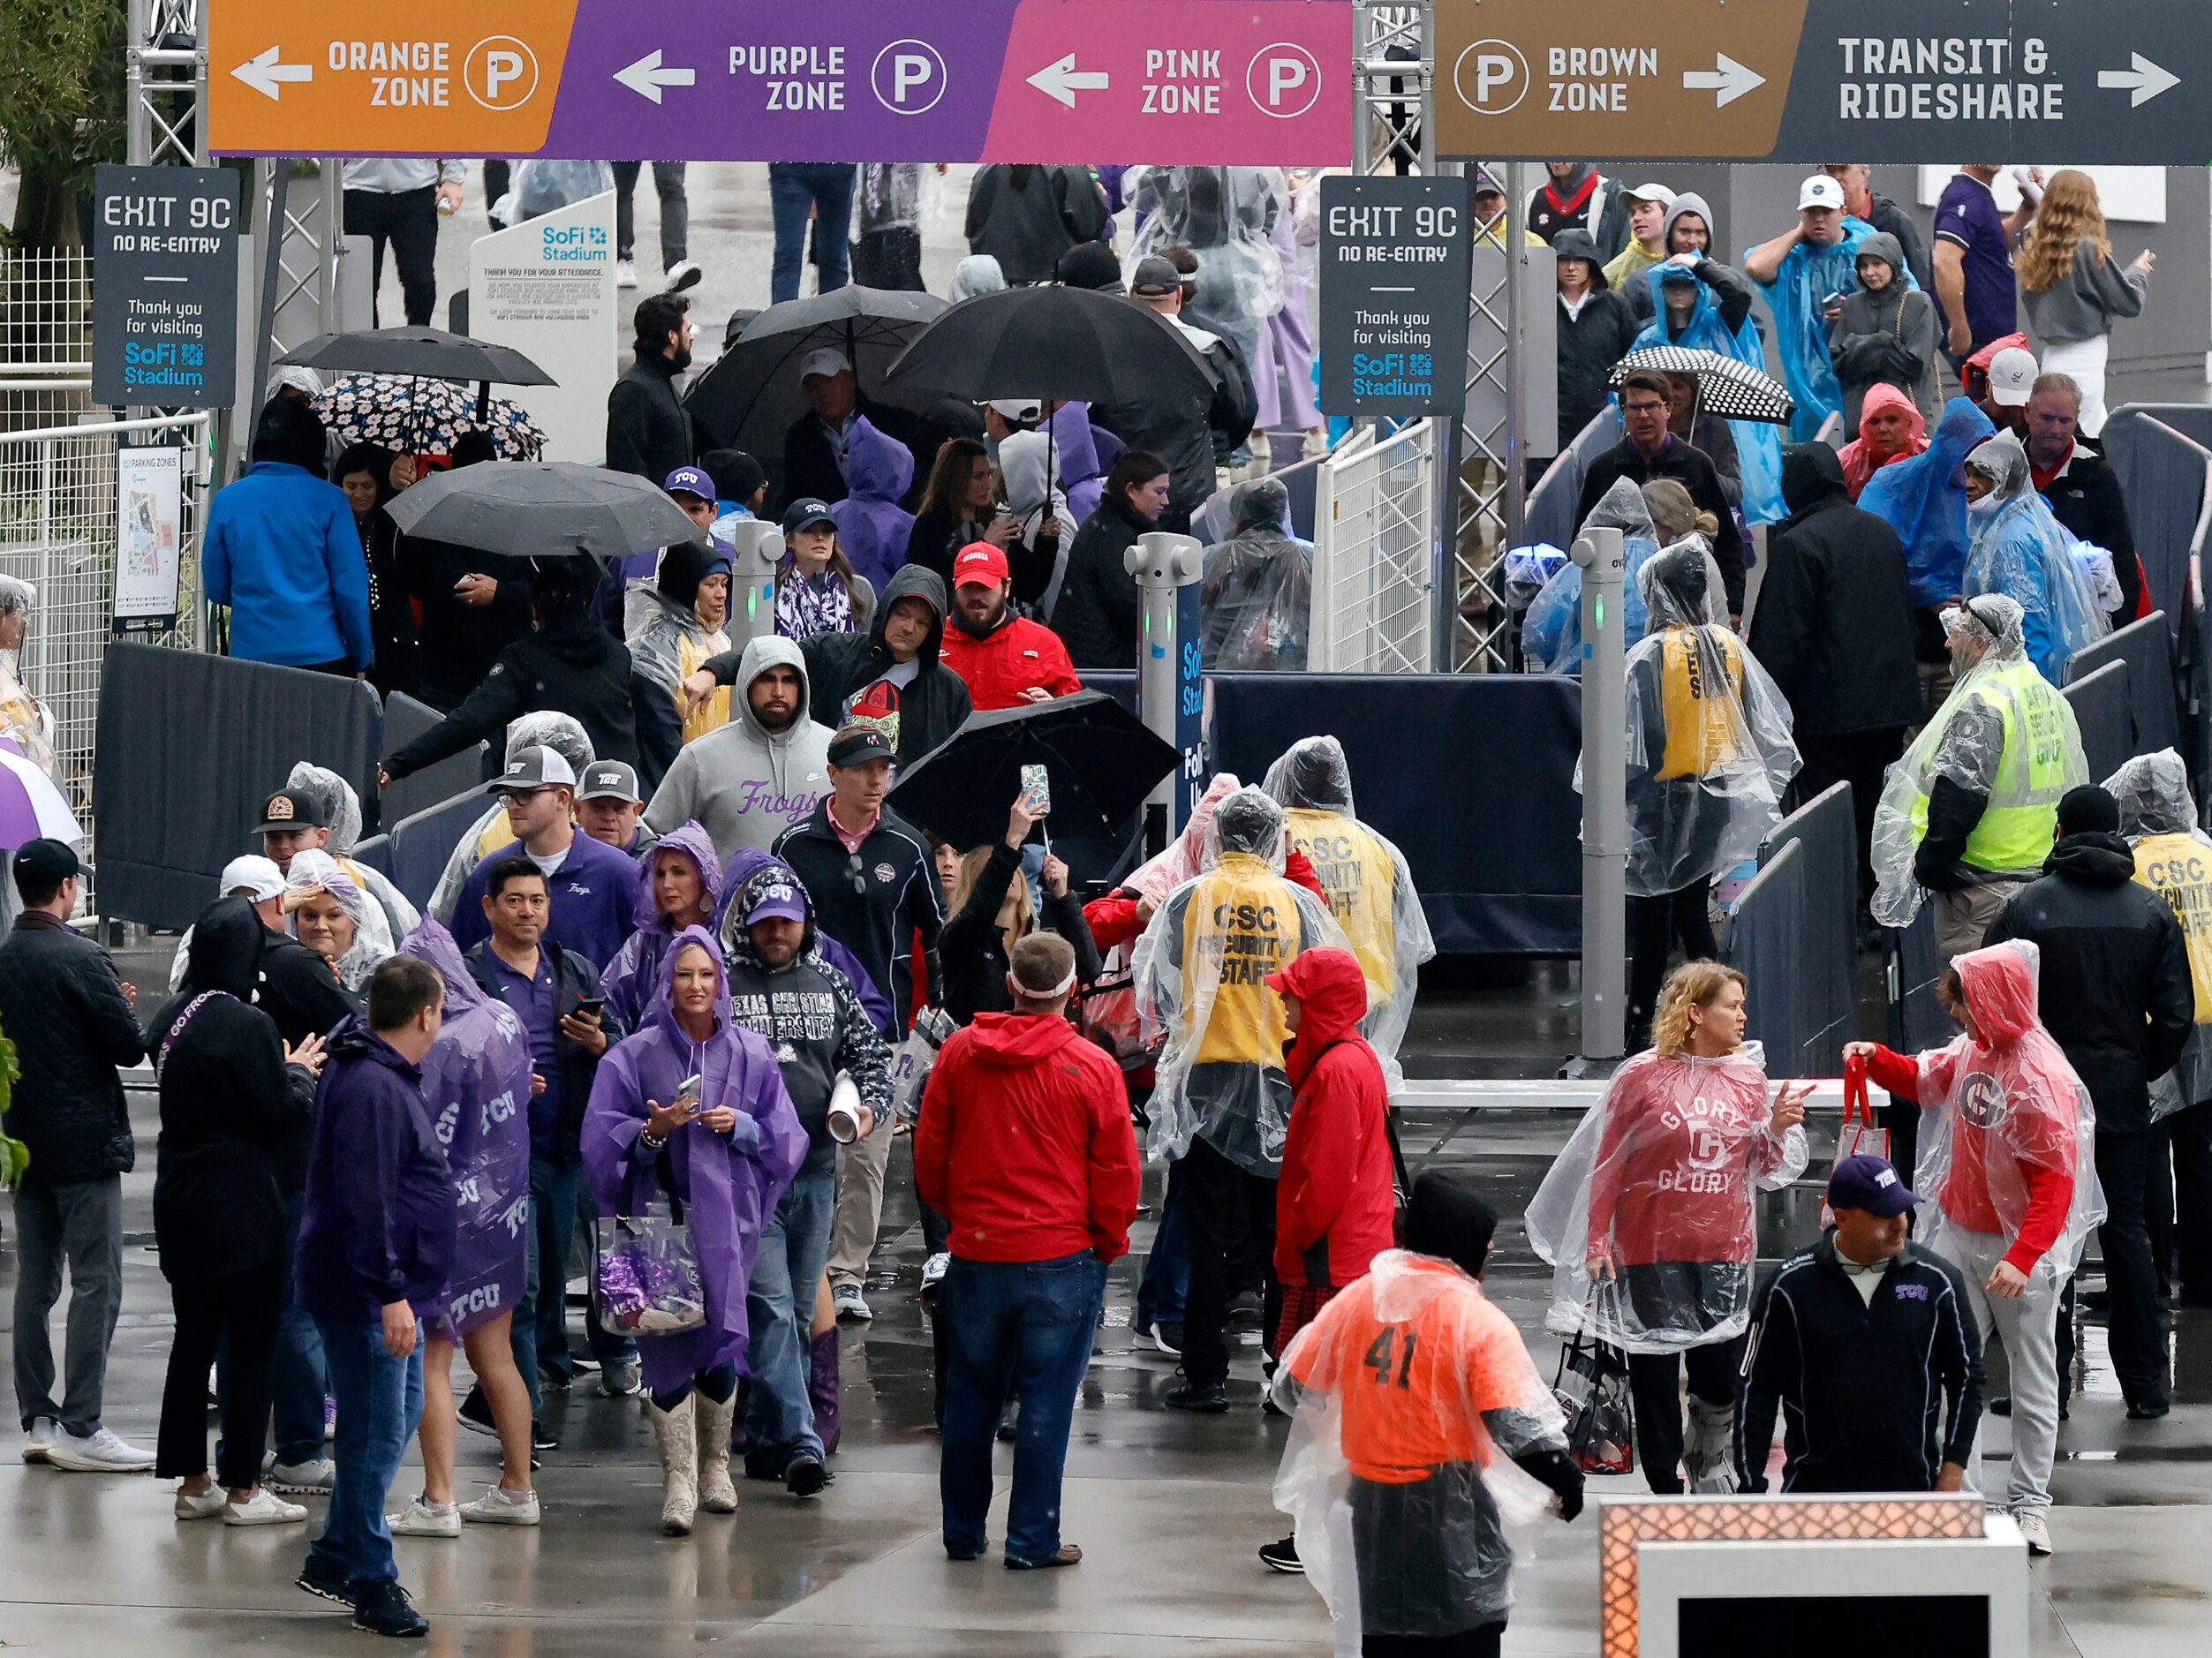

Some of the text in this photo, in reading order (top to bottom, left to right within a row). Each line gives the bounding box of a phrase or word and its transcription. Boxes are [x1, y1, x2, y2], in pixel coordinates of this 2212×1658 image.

[328, 41, 449, 71] ORANGE
[729, 46, 844, 75] PURPLE
[1146, 49, 1220, 79] PINK
[1548, 47, 1657, 76] BROWN
[1838, 38, 2049, 74] TRANSIT &
[487, 51, 524, 98] P
[895, 55, 932, 102] P
[1270, 58, 1307, 106] P
[1476, 55, 1514, 102] P
[370, 77, 449, 106] ZONE
[766, 81, 844, 110] ZONE
[1141, 85, 1220, 114] ZONE
[1548, 82, 1627, 111] ZONE
[1839, 83, 2064, 120] RIDESHARE
[104, 195, 231, 229] EXIT 9C
[1329, 206, 1457, 237] EXIT 9C
[113, 235, 221, 253] NO RE-ENTRY
[543, 227, 585, 245] SoFi
[542, 247, 607, 260] Stadium
[1339, 245, 1447, 262] NO RE-ENTRY
[128, 299, 202, 319] Thank you
[1355, 310, 1430, 328] Thank you
[126, 318, 203, 338] for visiting
[1353, 329, 1431, 348] for visiting
[125, 342, 177, 365] SoFi
[1352, 353, 1404, 375] SoFi
[125, 366, 203, 385] Stadium
[1353, 378, 1432, 396] Stadium
[132, 457, 177, 468] PARKING ZONES
[675, 471, 698, 485] TCU
[805, 504, 827, 514] TCU
[963, 551, 989, 562] GEORGIA
[598, 772, 623, 786] TCU
[736, 780, 819, 824] Frogs
[2148, 858, 2205, 886] CSC
[567, 882, 591, 895] Frogs
[1213, 904, 1277, 931] CSC
[730, 994, 768, 1017] TEXAS
[772, 992, 835, 1014] CHRISTIAN
[170, 1017, 186, 1036] GO
[1660, 1097, 1739, 1131] GLORY
[1657, 1168, 1733, 1195] GLORY
[449, 1283, 501, 1325] TCU
[1895, 1284, 1929, 1301] TCU
[1364, 1326, 1417, 1390] 41
